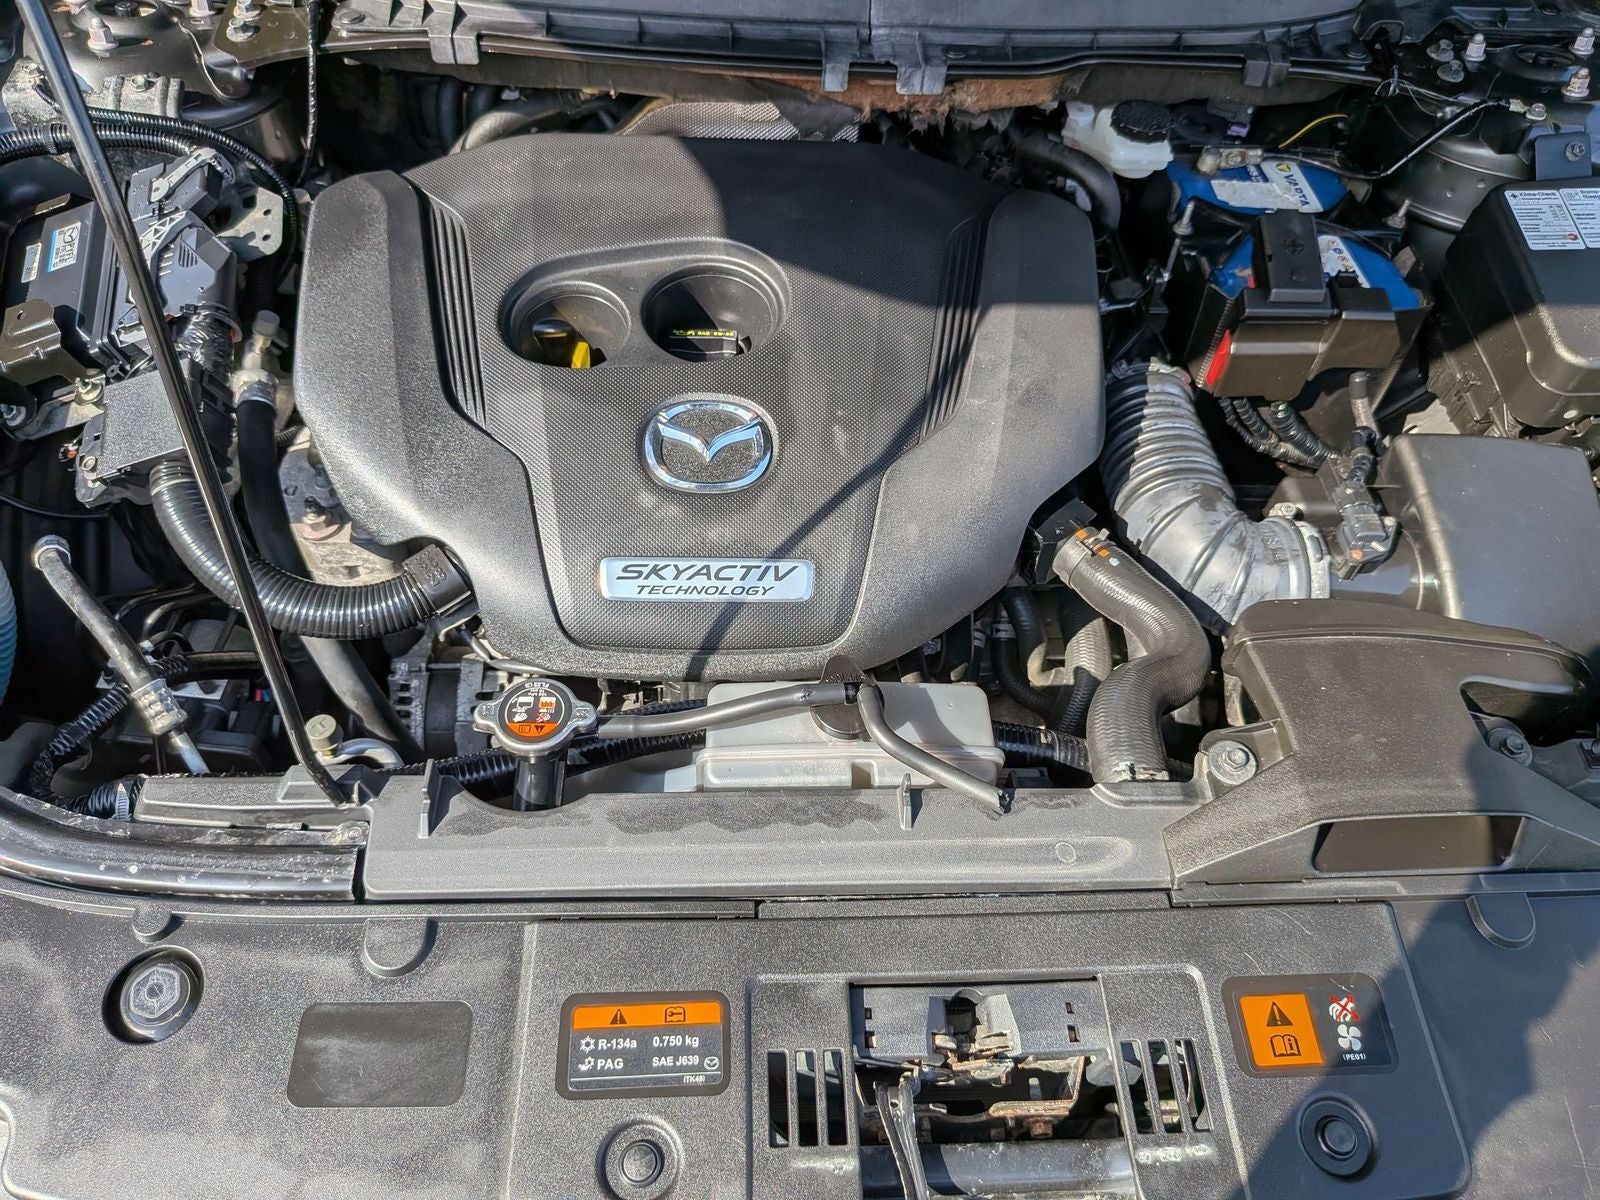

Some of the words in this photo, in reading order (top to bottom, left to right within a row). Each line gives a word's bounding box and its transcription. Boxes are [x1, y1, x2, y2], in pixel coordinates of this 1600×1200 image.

[616, 563, 799, 582] SKYACTIV
[637, 585, 775, 596] TECHNOLOGY
[598, 1038, 637, 1050] R-134a
[652, 1036, 682, 1048] 0.750
[685, 1035, 700, 1048] kg
[597, 1058, 624, 1070] PAG
[652, 1056, 674, 1067] SAE
[676, 1055, 700, 1066] J639
[1343, 1053, 1366, 1061] (PE01)
